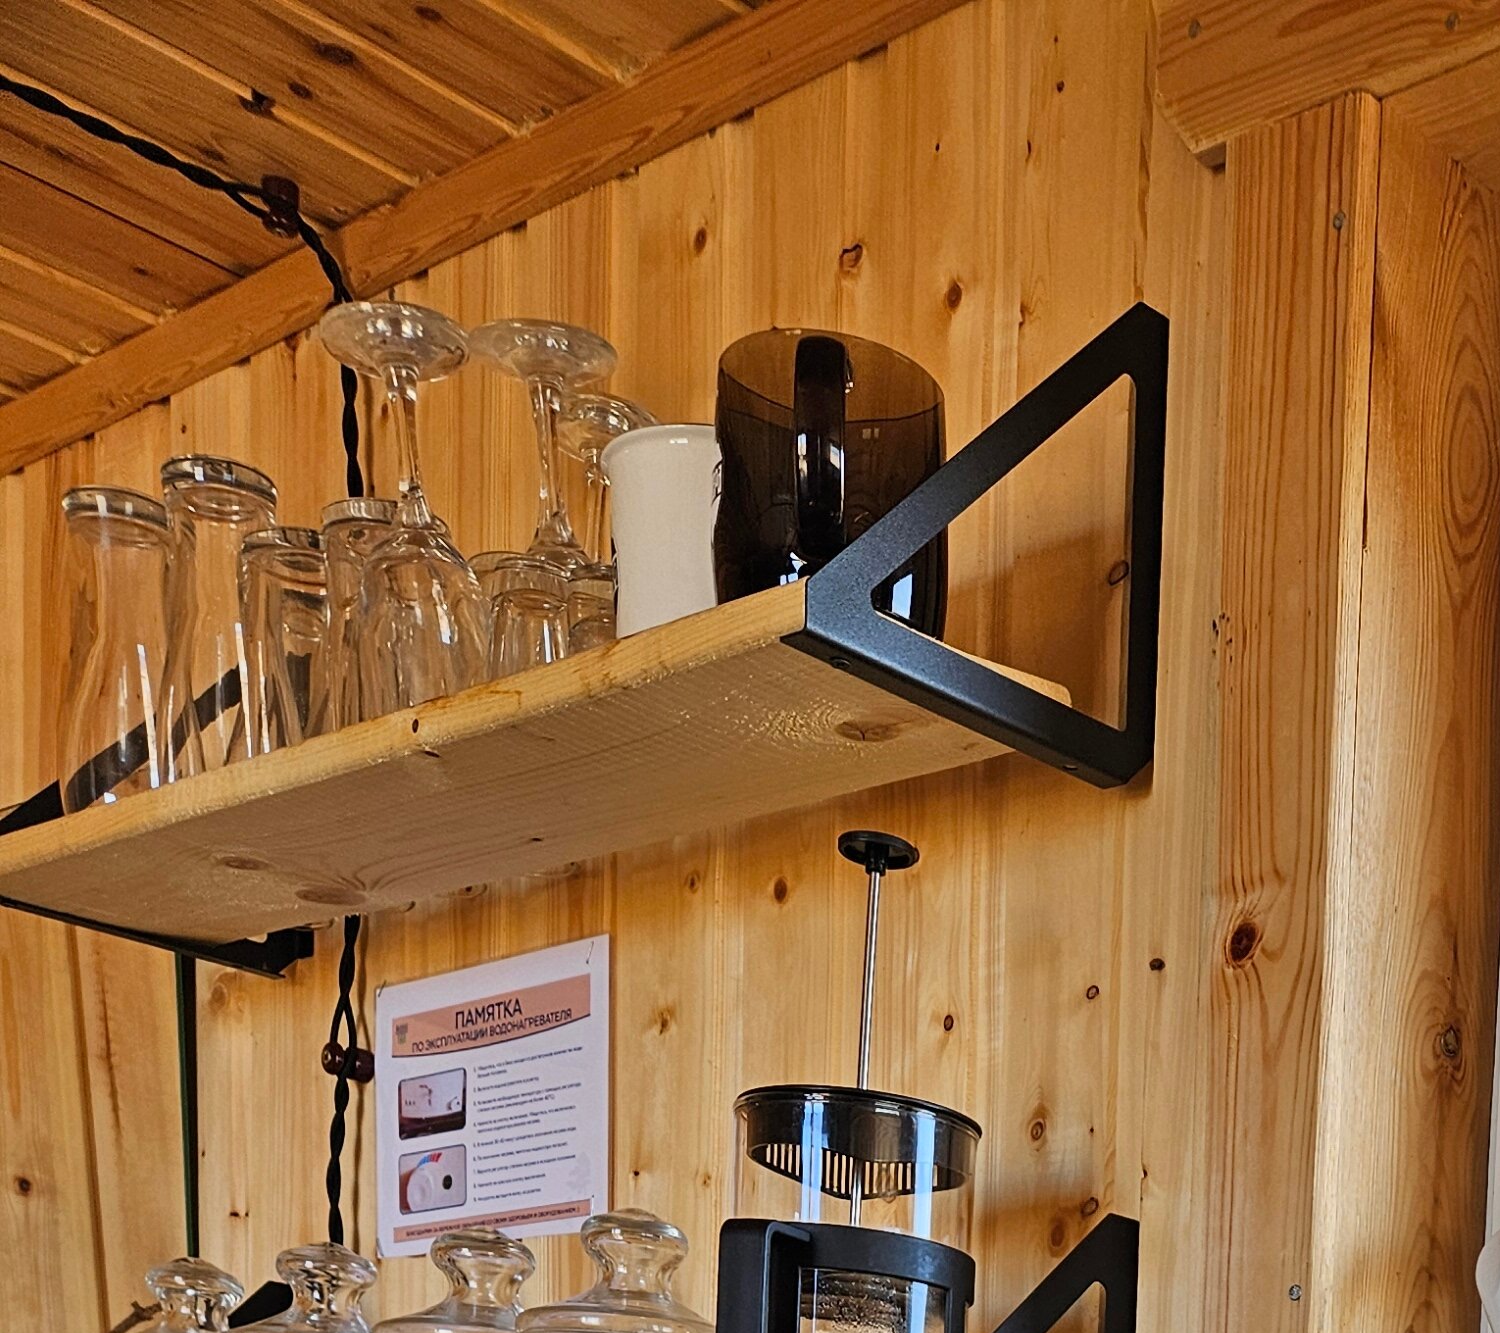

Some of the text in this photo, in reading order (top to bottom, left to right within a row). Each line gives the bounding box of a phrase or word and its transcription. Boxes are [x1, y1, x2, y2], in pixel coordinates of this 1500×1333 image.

[412, 1042, 425, 1053] ПО
[425, 1029, 488, 1051] ЭКСПЛУАТАЦИИ
[489, 1008, 573, 1037] ВОДОНАГРЕВАТЕЛЯ
[455, 998, 523, 1029] ПАМЯТКА
